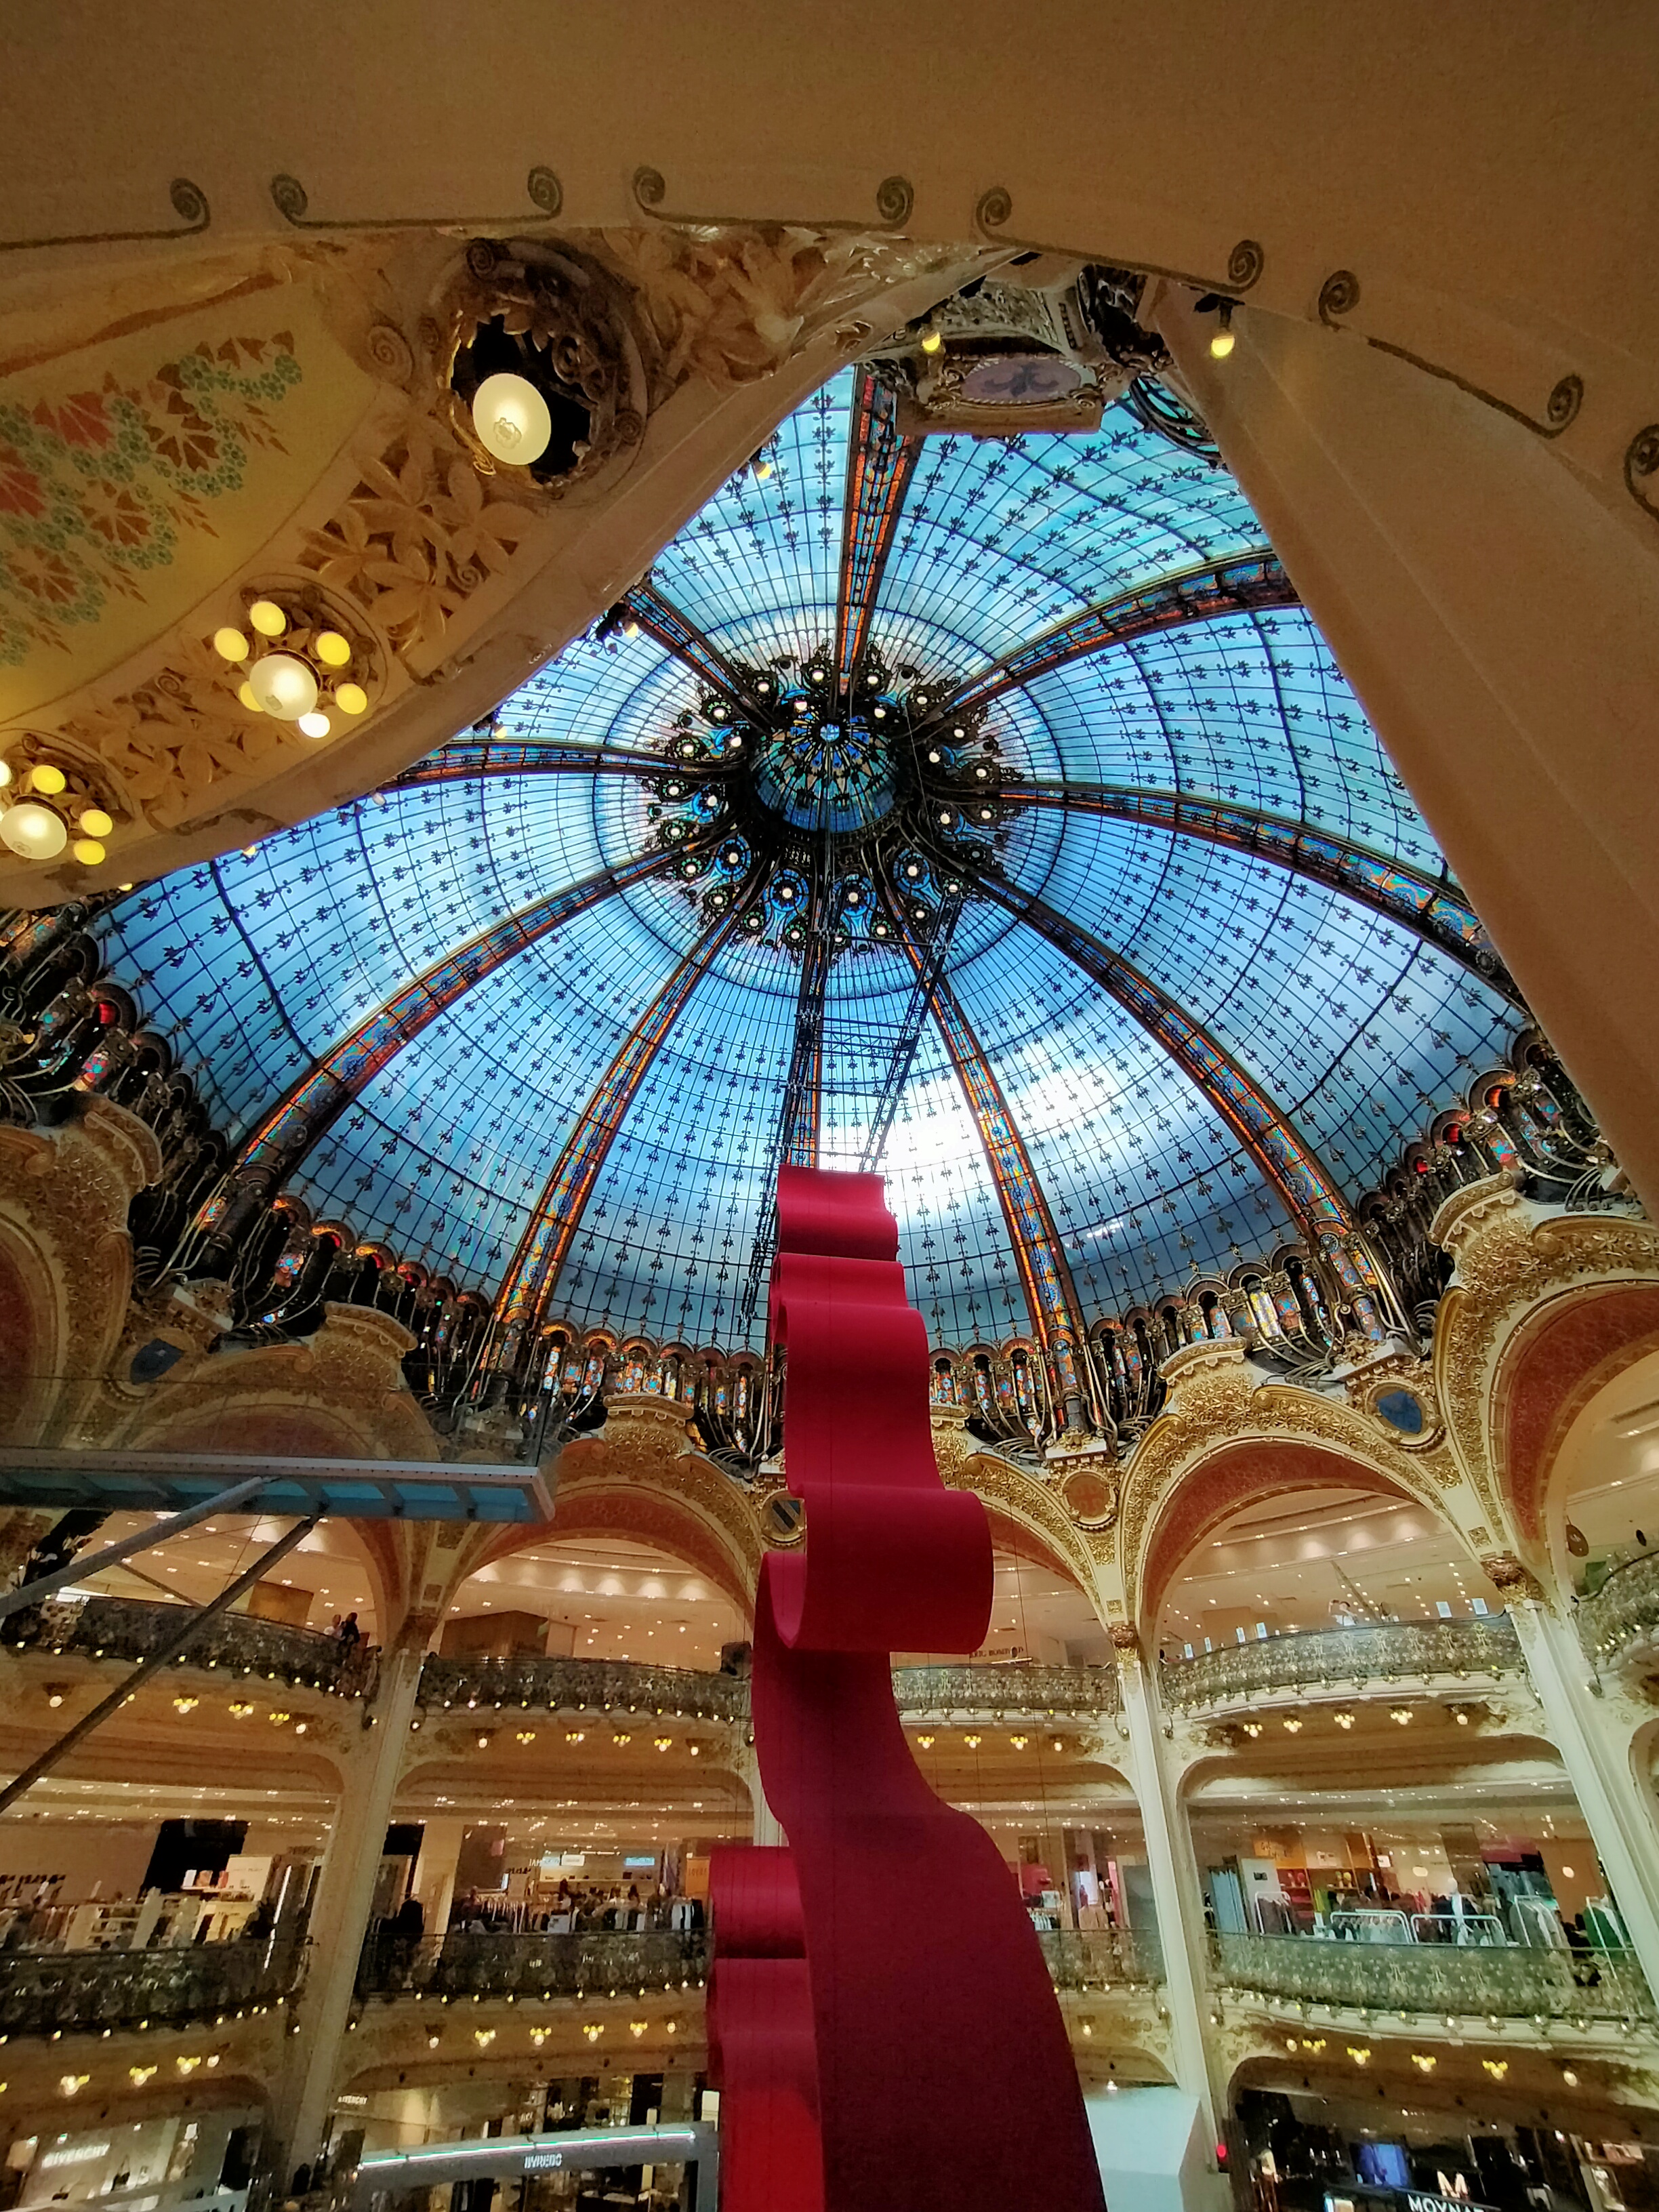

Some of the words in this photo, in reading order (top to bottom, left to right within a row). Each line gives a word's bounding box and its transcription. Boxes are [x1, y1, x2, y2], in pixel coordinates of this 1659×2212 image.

[41, 2143, 110, 2168] GIVENCHY
[524, 2153, 563, 2169] BYREDO
[1437, 2170, 1468, 2198] M
[1407, 2193, 1484, 2212] MOYN
